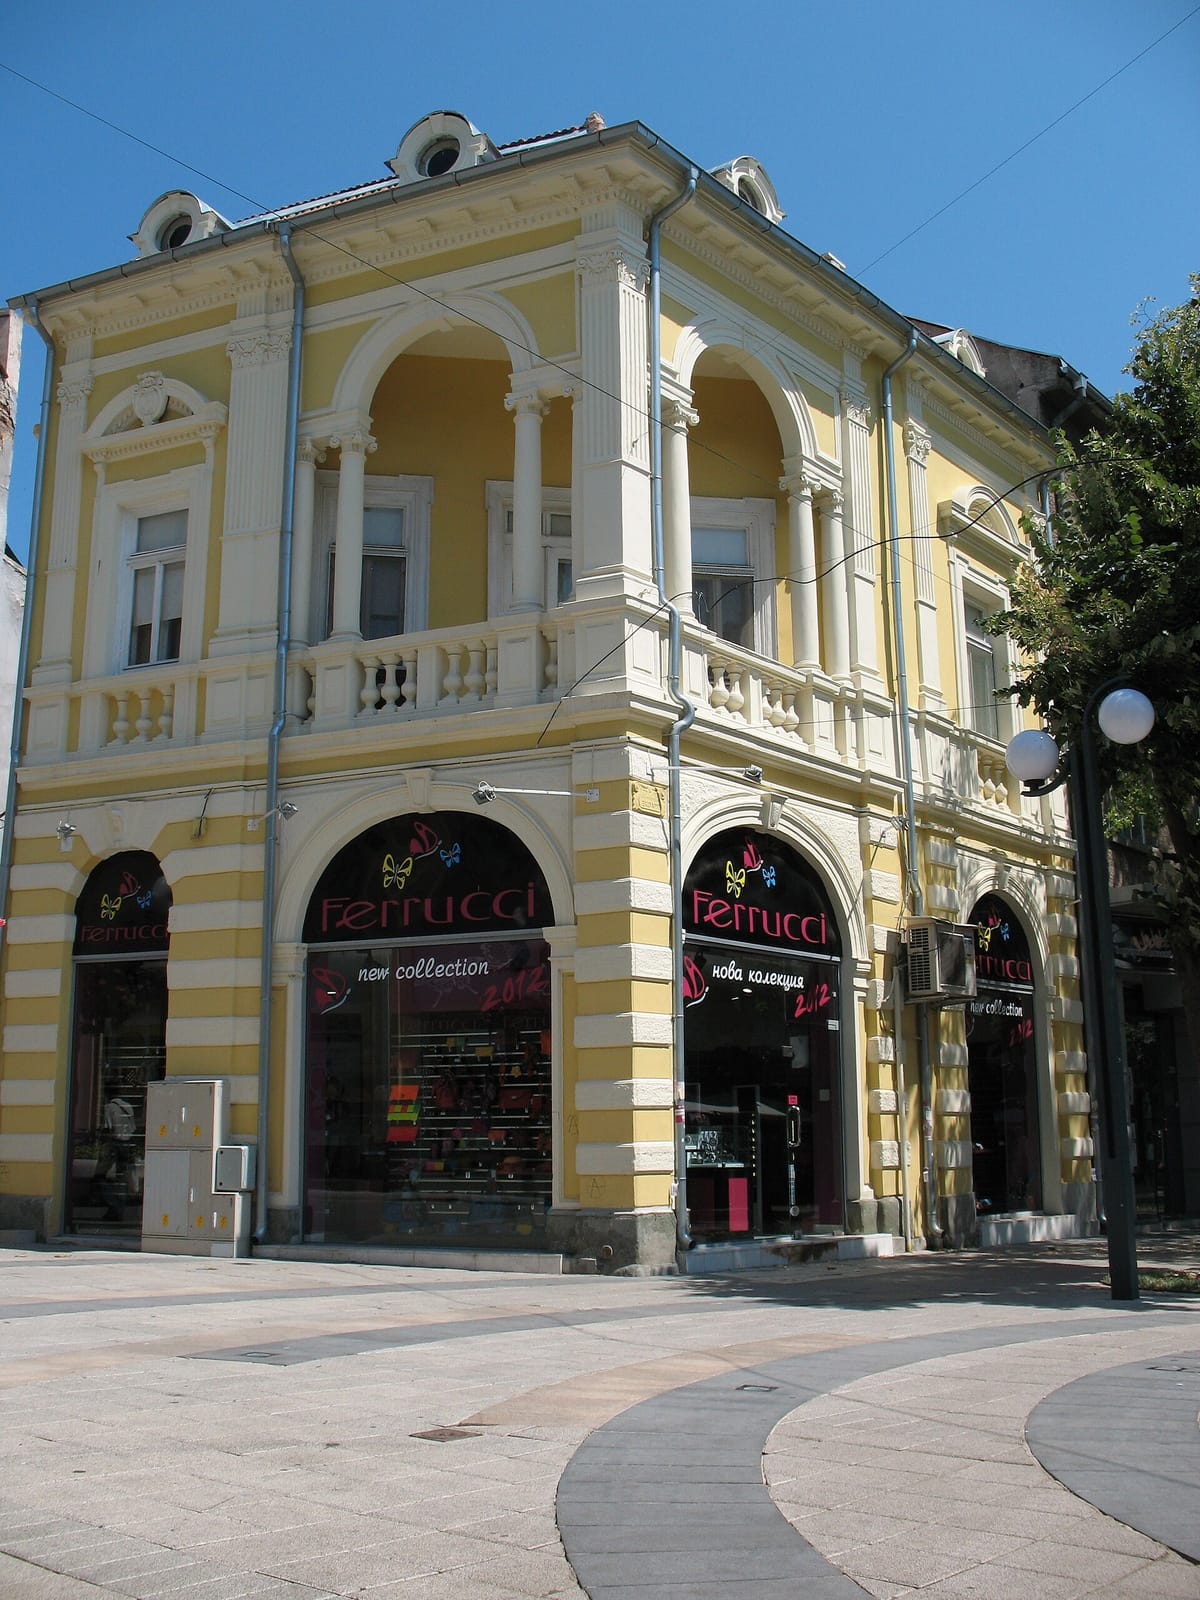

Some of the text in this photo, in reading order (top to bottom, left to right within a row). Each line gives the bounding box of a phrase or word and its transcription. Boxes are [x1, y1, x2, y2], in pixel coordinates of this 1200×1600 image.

[321, 881, 535, 932] Ferrucci
[693, 889, 827, 945] Ferrucci
[358, 957, 489, 982] new collection
[712, 960, 805, 992] нова колекция
[480, 967, 549, 1012] 2012
[794, 983, 831, 1018] 2012
[985, 1000, 1023, 1017] collection
